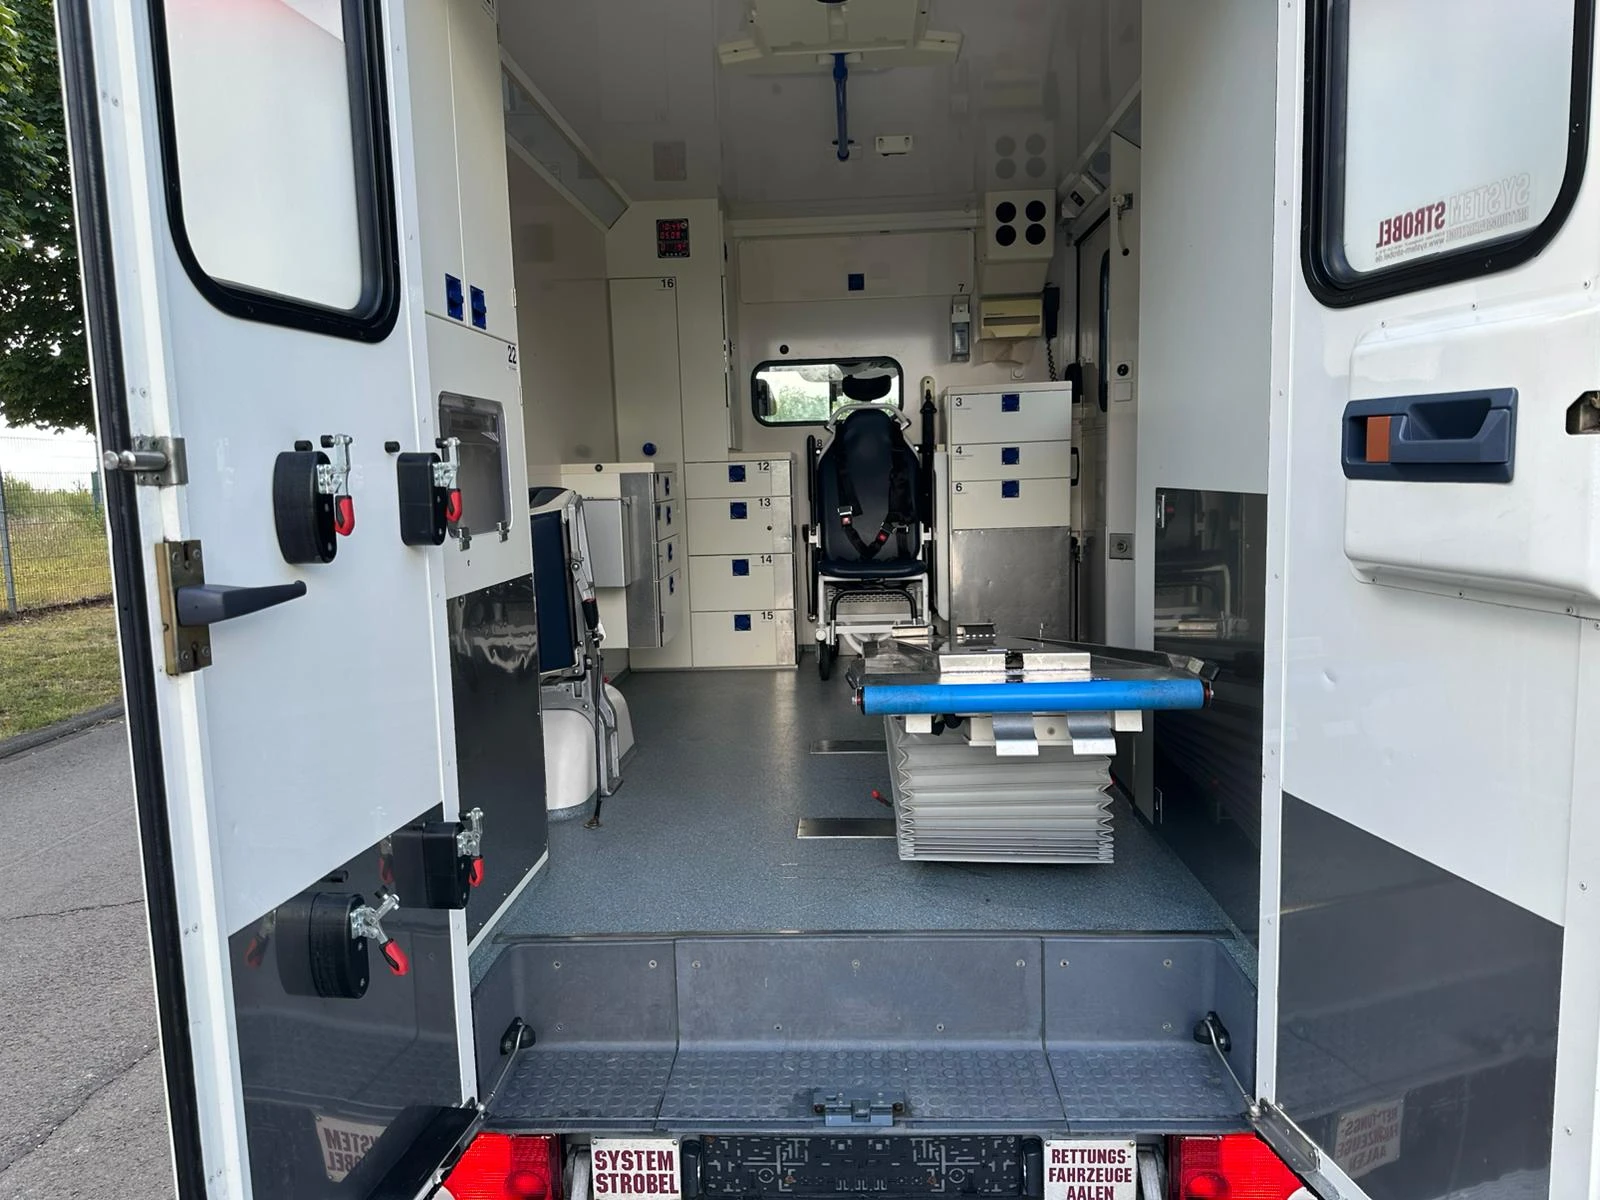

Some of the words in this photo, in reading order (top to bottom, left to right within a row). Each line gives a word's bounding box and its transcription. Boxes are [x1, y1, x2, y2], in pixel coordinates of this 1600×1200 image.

[661, 279, 674, 288] 16
[958, 283, 965, 292] 7
[507, 344, 517, 365] 22
[955, 397, 963, 407] 3
[816, 439, 823, 448] 8
[955, 446, 963, 455] 4
[757, 462, 770, 471] 12
[955, 482, 963, 492] 6
[758, 498, 771, 507] 13
[760, 555, 772, 564] 14
[761, 611, 774, 620] 15
[594, 1149, 674, 1171] SYSTEM
[1051, 1148, 1132, 1164] RETTUNGS-
[1048, 1167, 1133, 1183] FAHRZEUGE
[595, 1173, 679, 1194] STROBEL
[1066, 1185, 1114, 1200] AALEN
